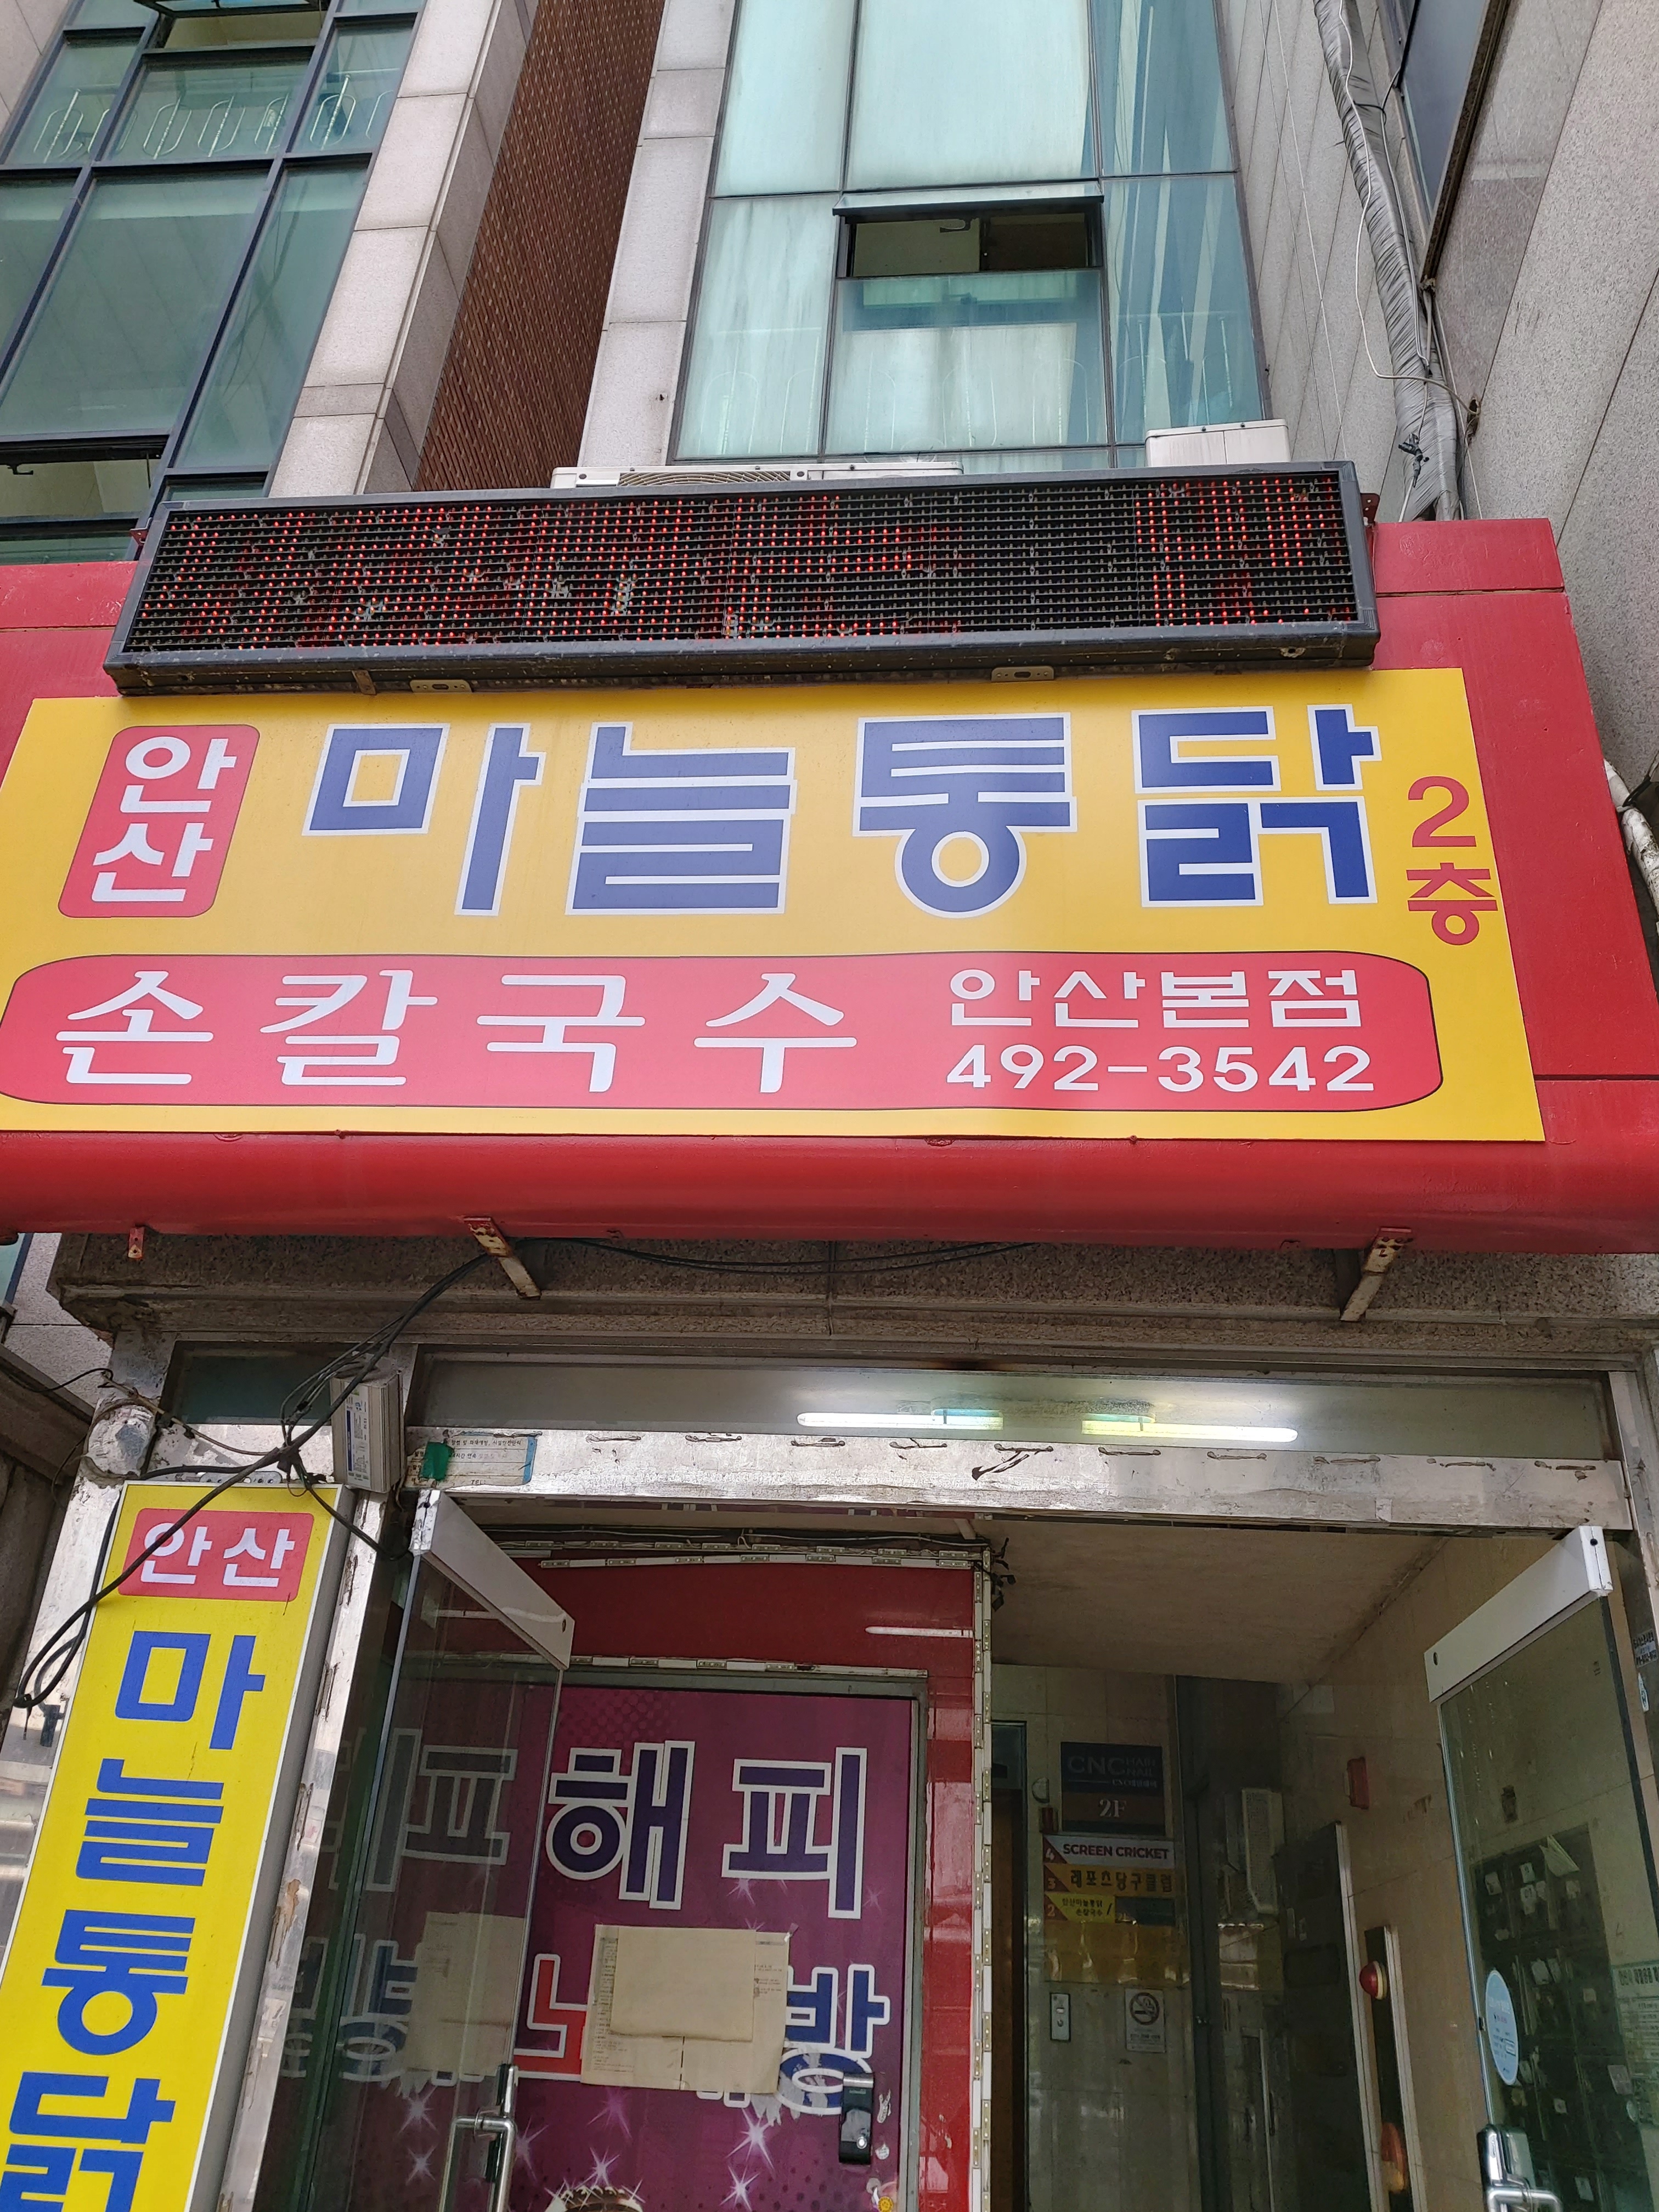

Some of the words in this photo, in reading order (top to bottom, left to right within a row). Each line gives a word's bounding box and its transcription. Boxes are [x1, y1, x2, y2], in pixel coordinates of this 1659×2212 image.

[92, 736, 237, 902] 안산
[302, 703, 1382, 918] 마늘통닭
[1406, 775, 1499, 946] 2층
[950, 969, 1362, 1028] 안산본점
[56, 969, 857, 1093] 손칼국수
[946, 1043, 1375, 1092] 492-3542
[140, 1522, 296, 1588] 안산
[1068, 1756, 1125, 1775] CNC
[546, 1740, 868, 1919] 해피
[1099, 1799, 1127, 1818] 2F
[1063, 1843, 1113, 1857] SCREEN
[1115, 1846, 1169, 1859] CRICKET
[1047, 1877, 1056, 1889] 3
[1047, 1904, 1056, 1917] 2
